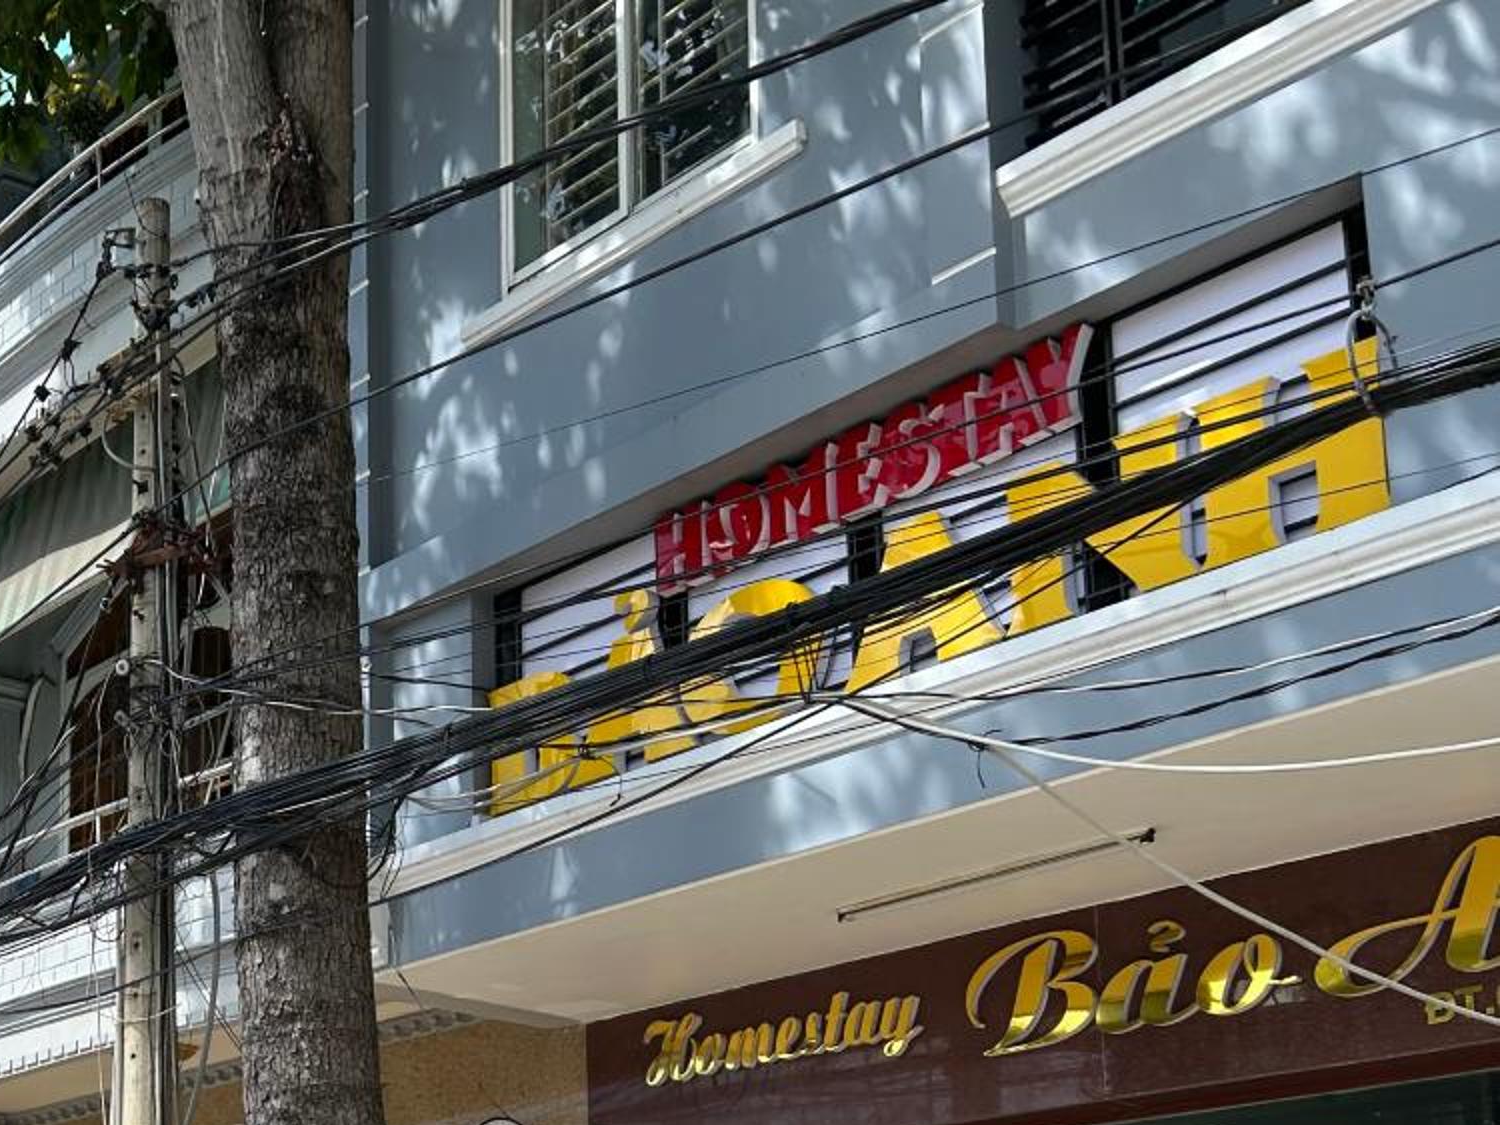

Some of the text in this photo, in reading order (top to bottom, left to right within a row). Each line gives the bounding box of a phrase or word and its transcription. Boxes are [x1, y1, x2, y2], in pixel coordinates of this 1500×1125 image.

[654, 322, 1093, 596] HOMESTAY
[644, 990, 923, 1087] Homestay
[965, 919, 1301, 1057] Bảo
